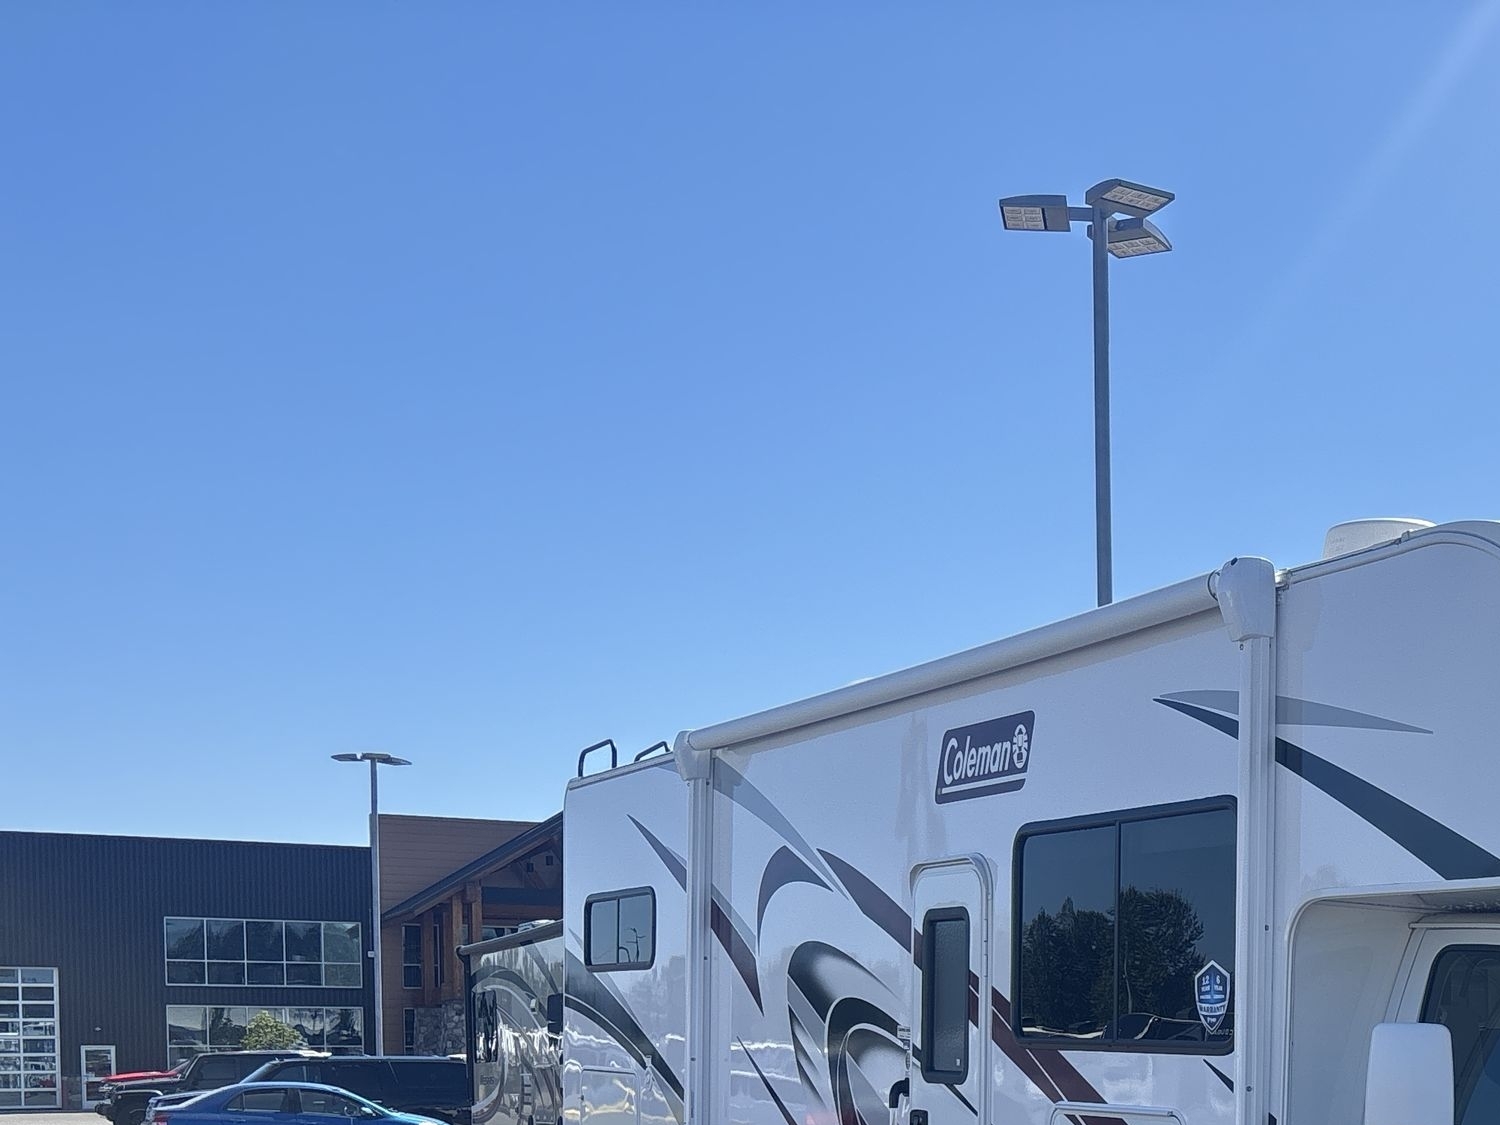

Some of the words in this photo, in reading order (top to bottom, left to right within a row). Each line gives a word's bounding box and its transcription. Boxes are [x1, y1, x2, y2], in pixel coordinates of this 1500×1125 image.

[943, 735, 1011, 785] Coleman
[1202, 975, 1210, 986] 12
[1200, 1003, 1226, 1014] WARRANTY
